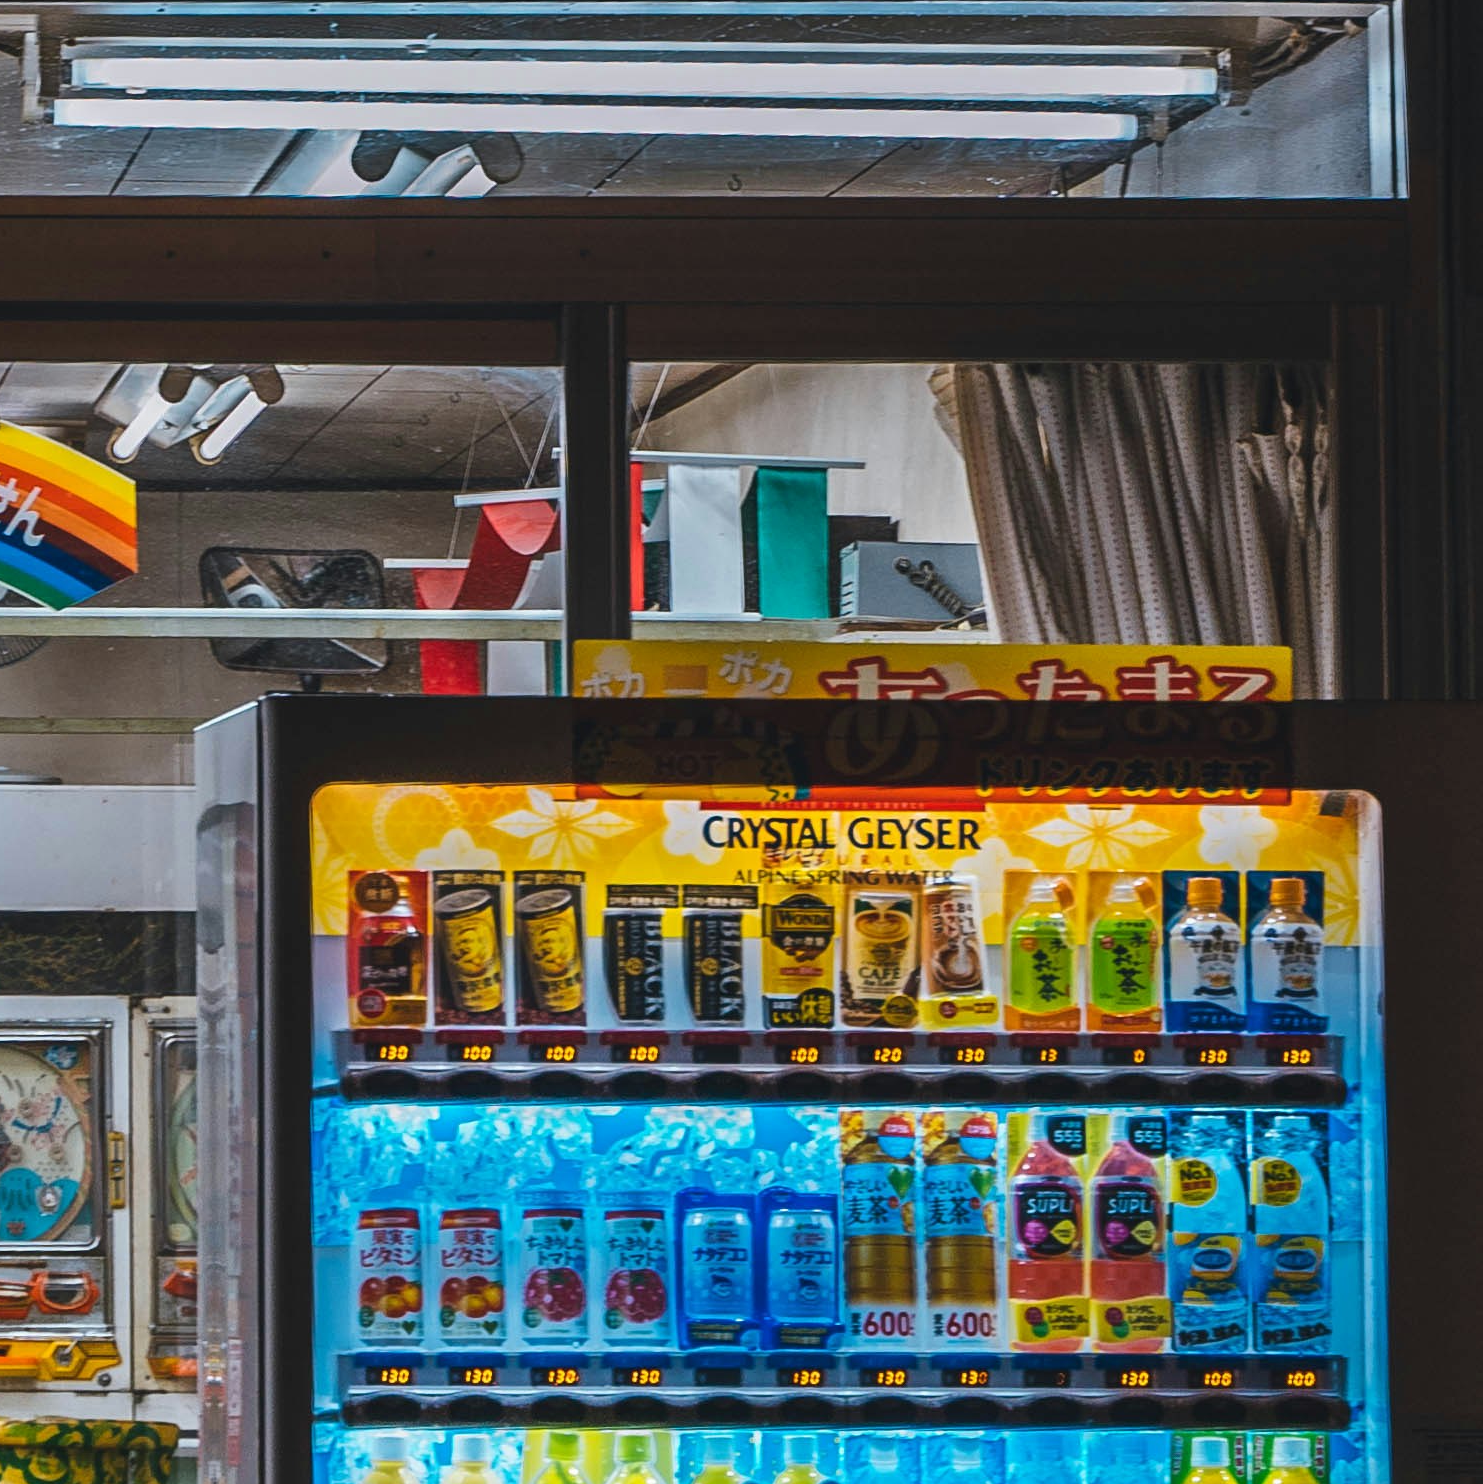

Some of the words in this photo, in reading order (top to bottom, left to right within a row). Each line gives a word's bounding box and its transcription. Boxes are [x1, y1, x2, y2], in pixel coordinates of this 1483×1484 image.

[703, 815, 837, 850] CRYSTAL
[847, 816, 982, 850] GEYSER
[733, 869, 805, 886] ALPINE
[806, 869, 881, 887] SPRING
[886, 869, 956, 887] WATER
[644, 920, 664, 1015] BLACK
[720, 920, 742, 1015] BLACK
[380, 1045, 409, 1060] 130
[463, 1045, 492, 1061] 100
[546, 1046, 575, 1062] 100
[629, 1046, 659, 1062] 100
[791, 1047, 819, 1063] 100
[874, 1047, 902, 1063] 120
[957, 1048, 985, 1063] 130
[1200, 1049, 1228, 1064] 130
[1283, 1049, 1311, 1064] 130
[1053, 1130, 1083, 1144] 555
[1134, 1130, 1164, 1144] 555
[847, 1197, 888, 1226] 麦茶
[928, 1198, 970, 1226] 麦茶
[862, 1311, 911, 1337] 600
[945, 1311, 994, 1338] 600
[381, 1368, 410, 1384] 130
[465, 1368, 493, 1384] 130
[548, 1369, 577, 1384] 130
[631, 1369, 660, 1384] 130
[793, 1370, 821, 1385] 130
[877, 1370, 905, 1385] 130
[961, 1370, 988, 1385] 130
[1121, 1371, 1149, 1386] 130
[1287, 1372, 1316, 1387] 100
